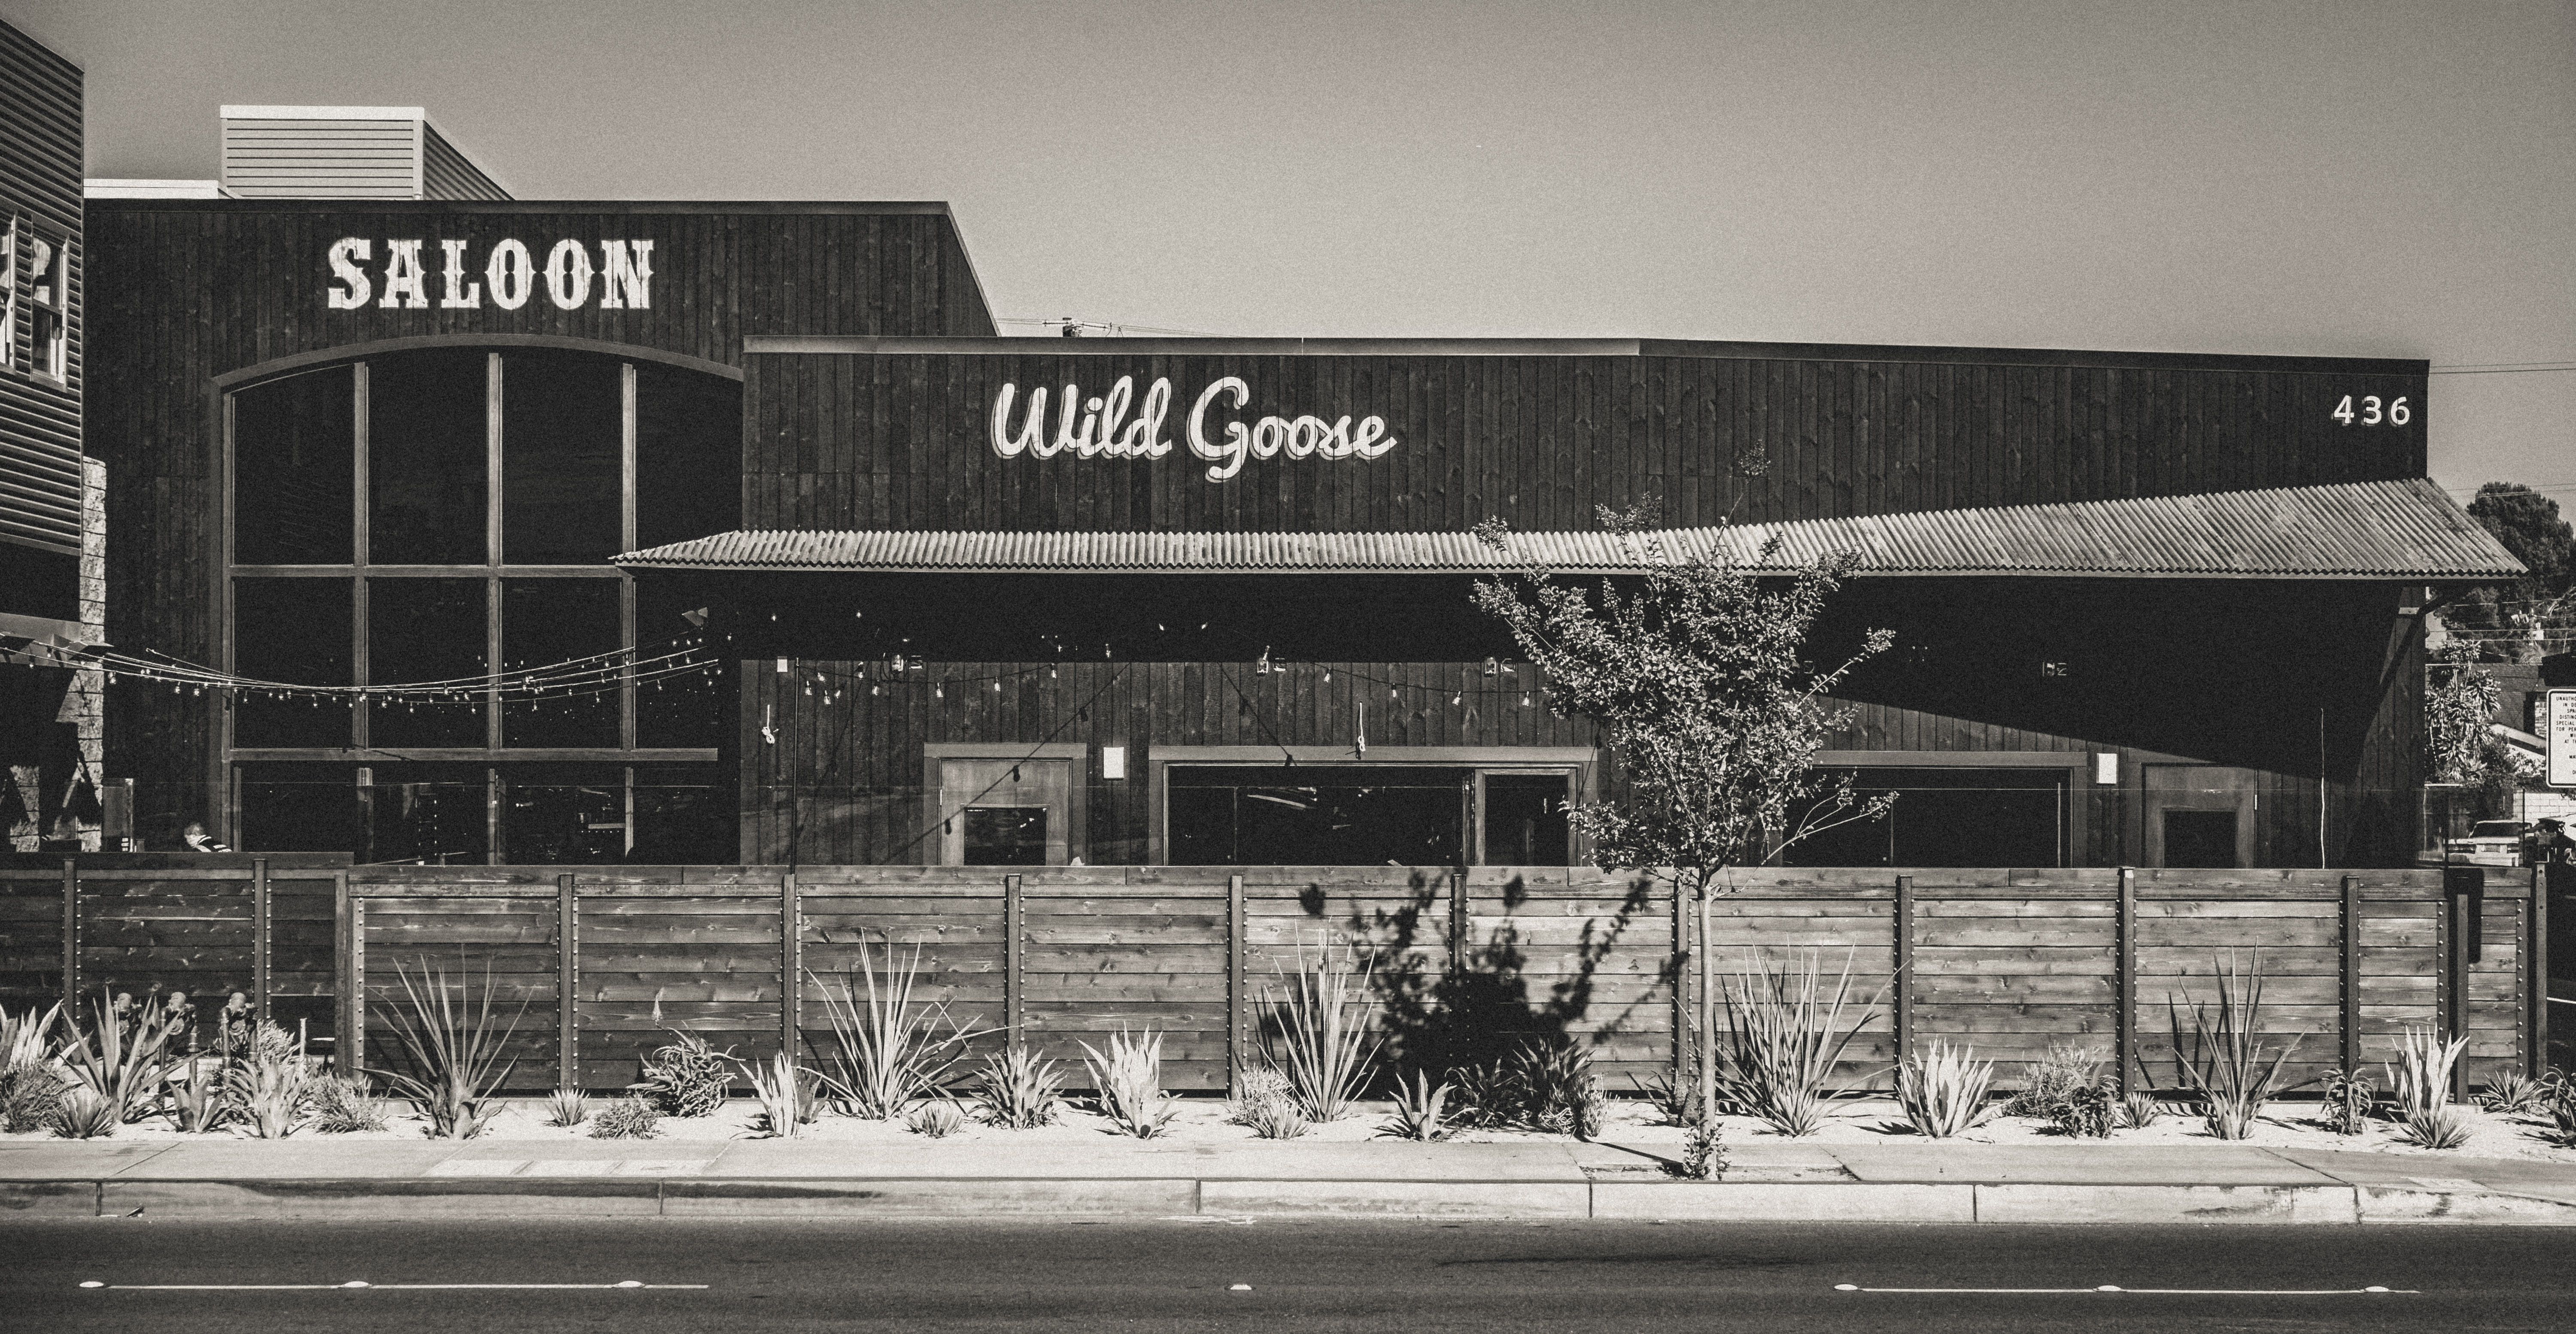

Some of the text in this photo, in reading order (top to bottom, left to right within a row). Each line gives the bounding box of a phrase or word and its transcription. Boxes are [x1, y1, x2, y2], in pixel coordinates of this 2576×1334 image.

[328, 237, 654, 310] SALOON
[990, 375, 1397, 483] Wild Goose
[2331, 395, 2410, 427] 436
